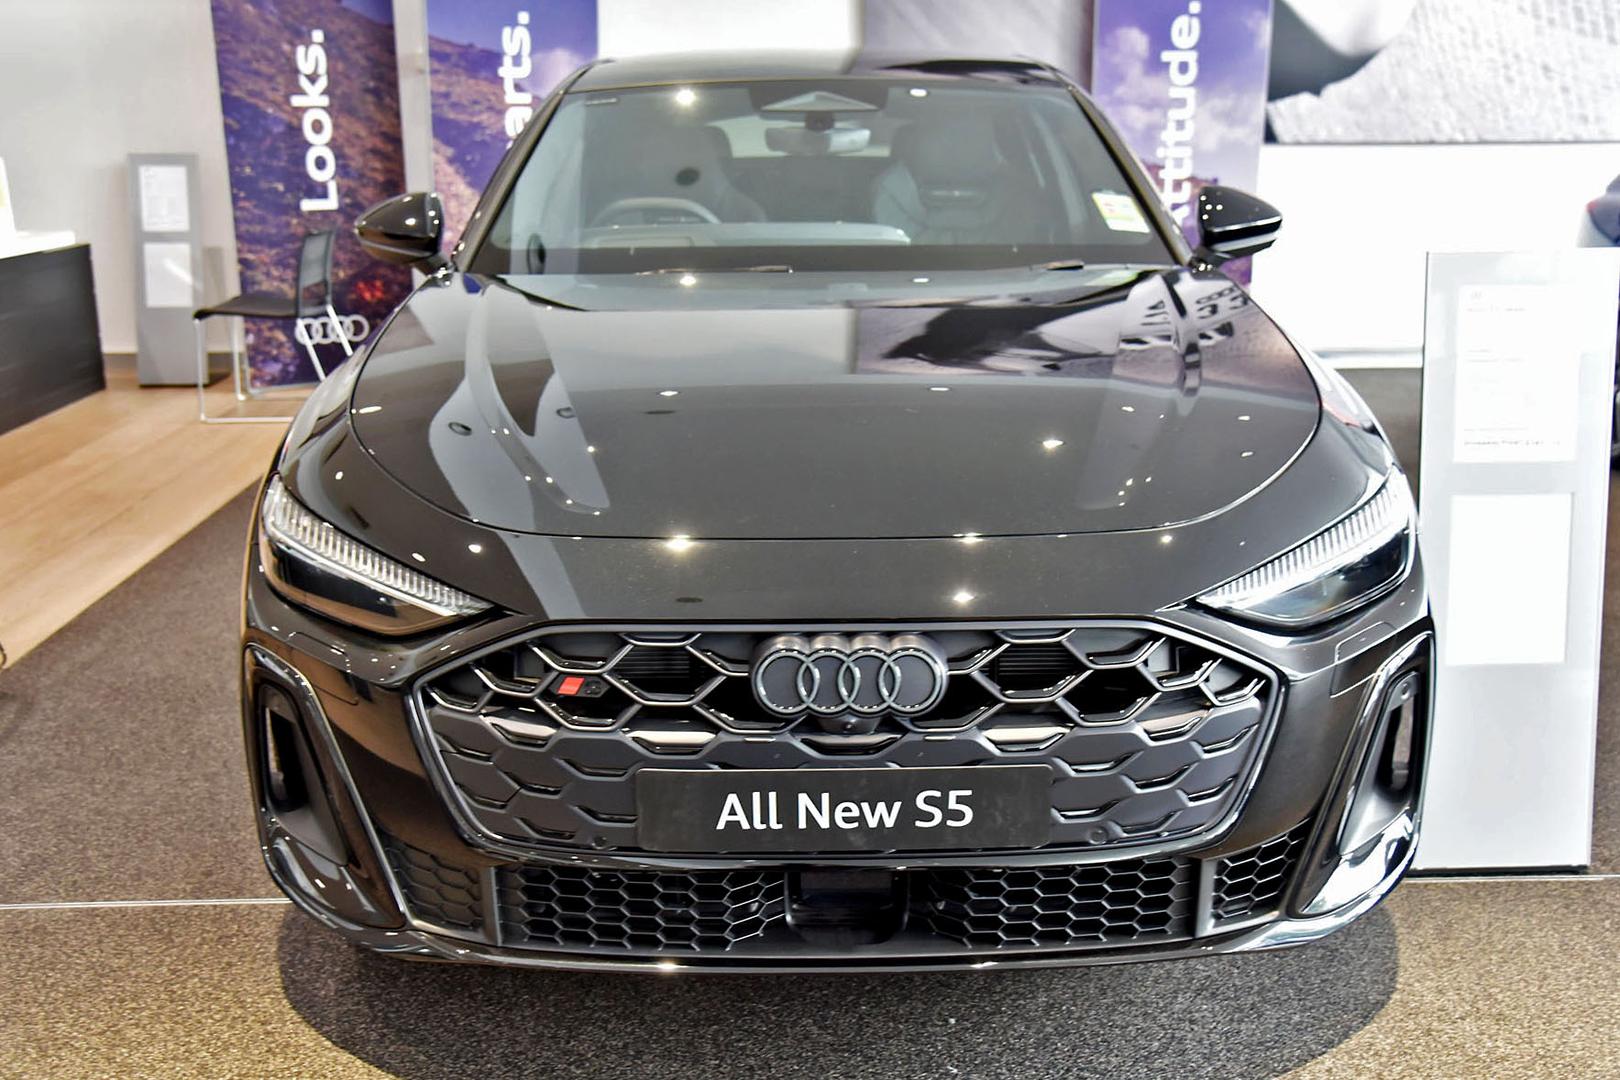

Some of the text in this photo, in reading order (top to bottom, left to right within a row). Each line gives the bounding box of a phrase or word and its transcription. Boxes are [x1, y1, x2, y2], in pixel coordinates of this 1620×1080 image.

[290, 29, 339, 211] Looks.
[498, 10, 533, 149] arts.
[715, 789, 974, 830] All New S5
